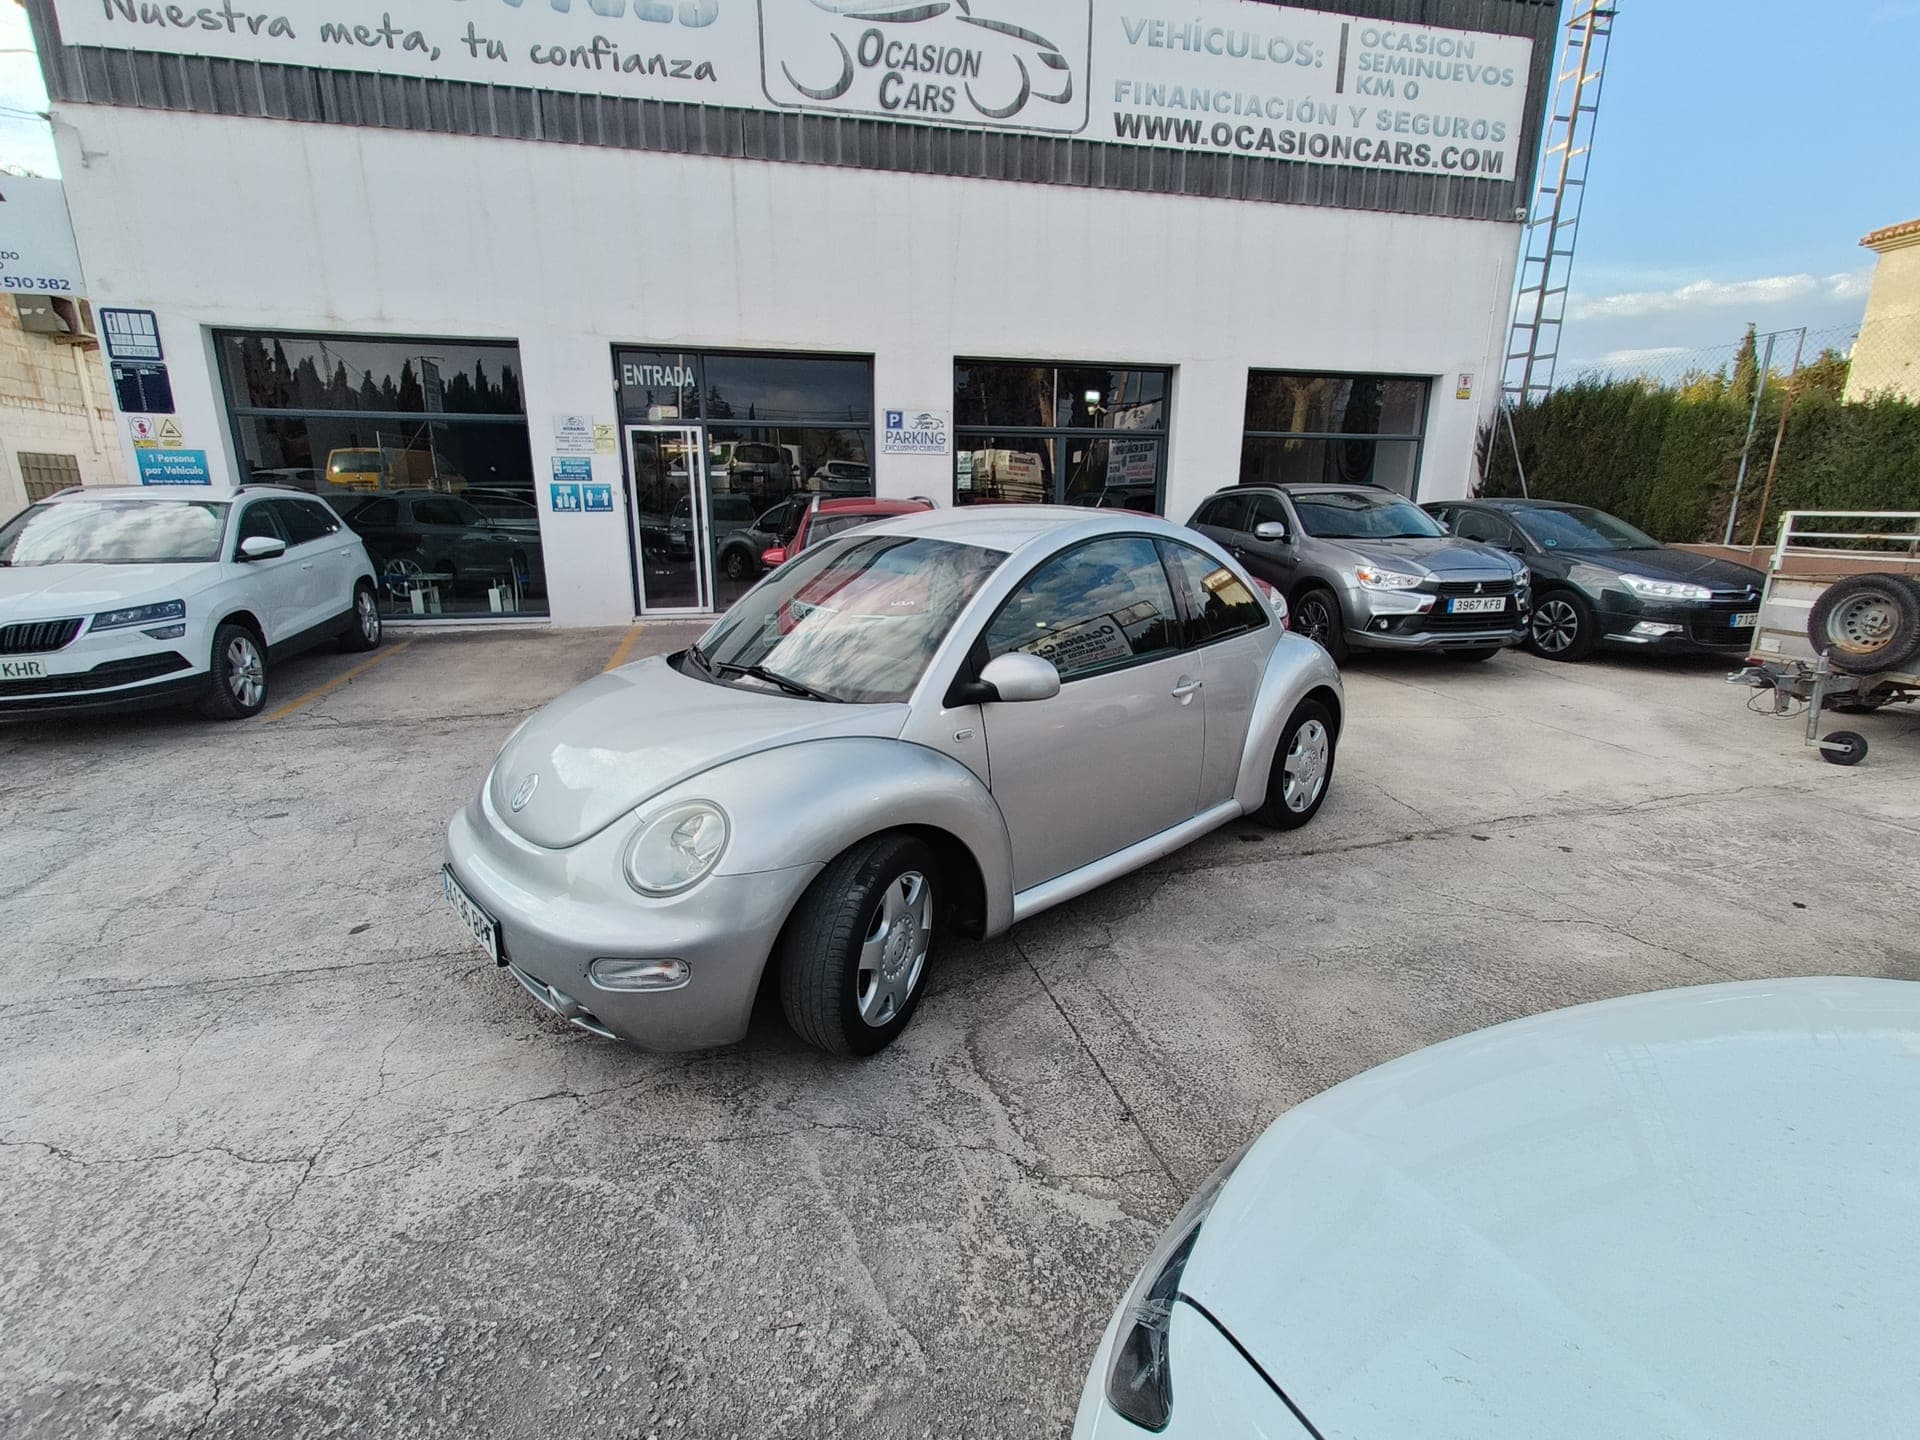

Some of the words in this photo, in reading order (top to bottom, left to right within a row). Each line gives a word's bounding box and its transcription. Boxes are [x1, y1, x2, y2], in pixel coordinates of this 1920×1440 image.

[104, 0, 296, 39] Nuestra
[320, 12, 441, 61] meta,
[461, 21, 508, 62] tu
[530, 35, 717, 82] confianza
[857, 28, 982, 78] OCASION
[1120, 16, 1324, 69] VEHÍCULOS:
[1360, 28, 1475, 59] OCASION
[1357, 53, 1514, 87] SEMINUEVOS
[879, 72, 956, 114] CARS
[1355, 75, 1395, 98] KM
[1114, 79, 1338, 126] FINANCIACIÓN
[1349, 105, 1367, 128] Y
[1376, 109, 1506, 143] SEGUROS
[1113, 112, 1504, 174] WWW.OCASIONCARS.COM
[0, 251, 20, 261] DO
[4, 276, 34, 289] 510
[36, 278, 71, 291] 382
[623, 364, 695, 387] ENTRADA
[890, 414, 900, 427] P
[886, 431, 946, 445] PARKING
[1456, 600, 1481, 611] 3967
[2, 661, 42, 677] KHR
